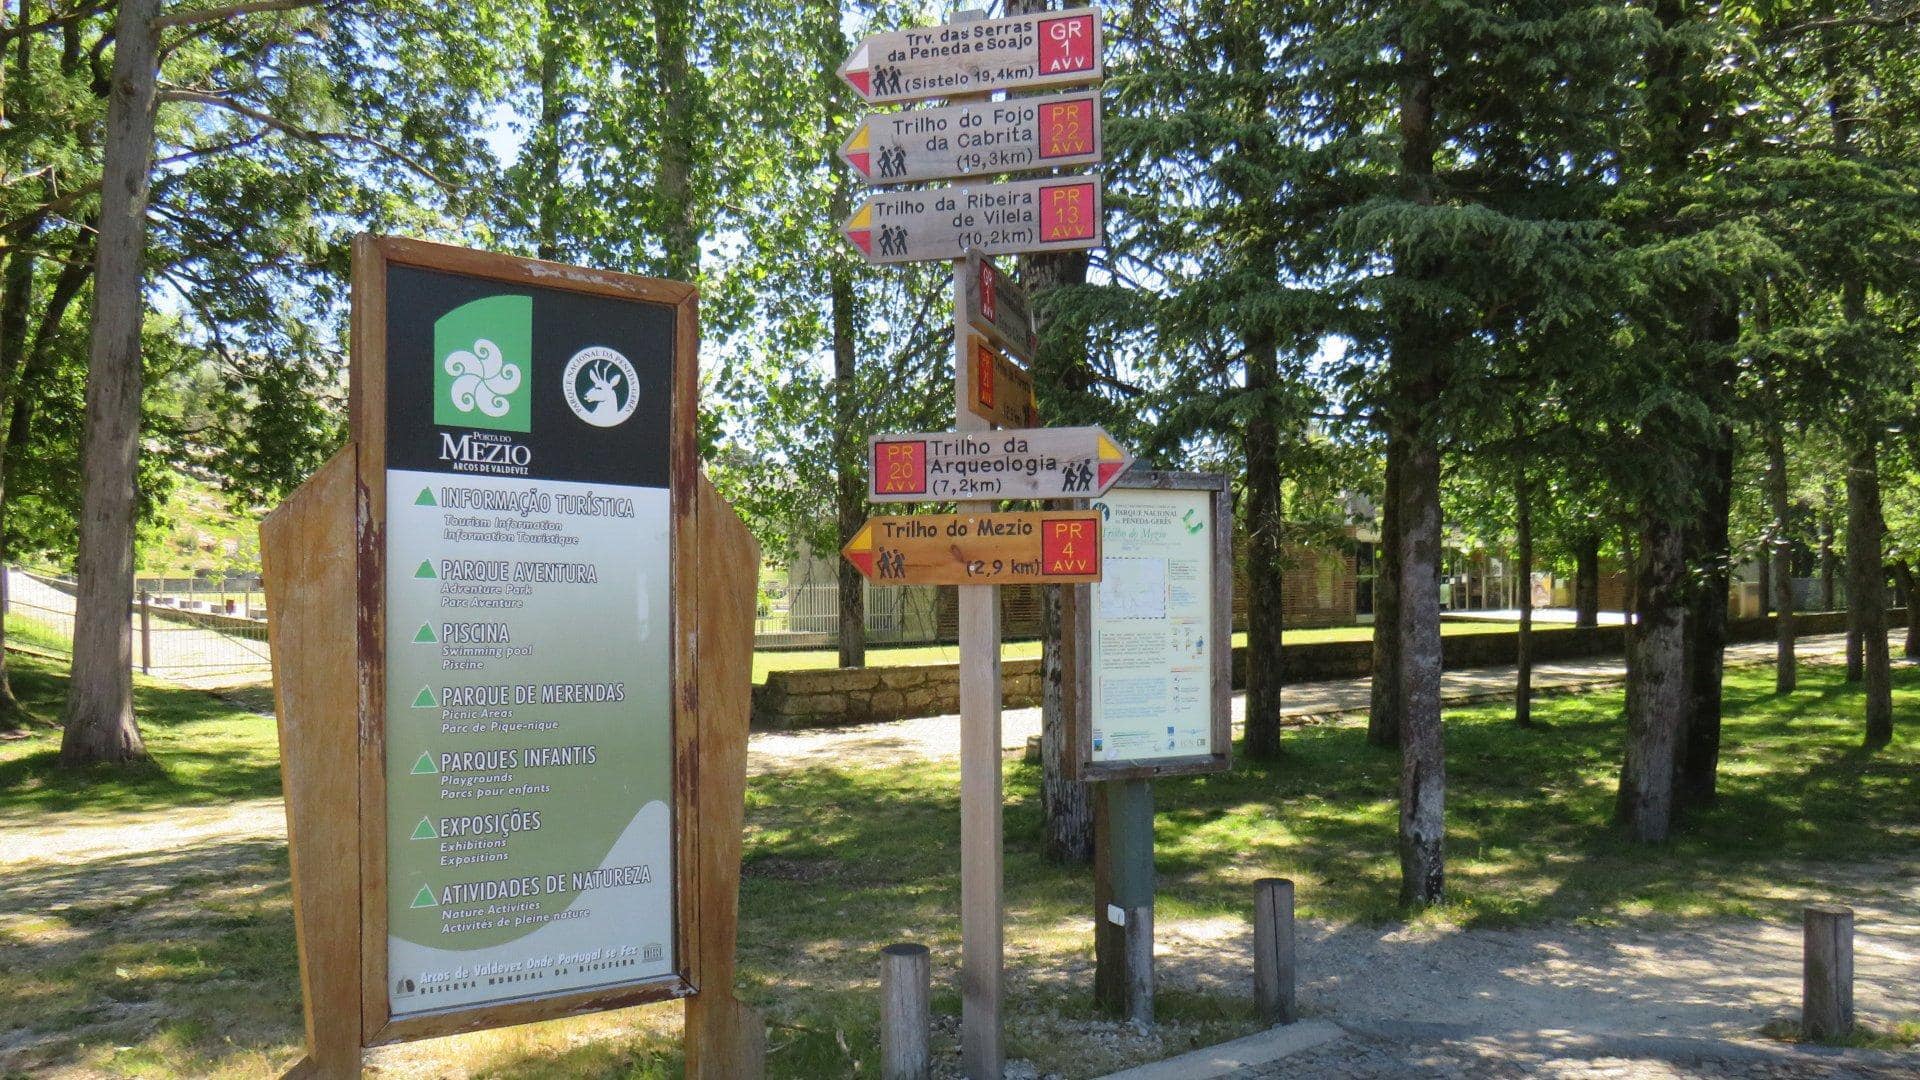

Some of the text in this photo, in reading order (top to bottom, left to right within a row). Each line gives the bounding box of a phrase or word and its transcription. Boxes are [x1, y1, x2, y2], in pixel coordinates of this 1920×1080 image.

[907, 20, 1033, 46] Trv. das Serras
[1050, 20, 1083, 40] GR
[888, 34, 1033, 62] da Peneda e Soajo
[1061, 40, 1070, 56] 1
[1050, 56, 1084, 71] AVV
[905, 66, 1034, 93] (Sistelo 19,4km)
[893, 108, 1034, 136] Trilho do Fojo
[1052, 106, 1079, 122] PR
[926, 128, 1033, 151] da Cabrita
[1051, 124, 1078, 141] 22
[1051, 141, 1084, 154] AVV
[957, 149, 1034, 172] (19,3km)
[875, 190, 1033, 217] Trilho da Ribeira
[1053, 189, 1080, 205] PR
[952, 207, 1033, 228] de Vilela
[1056, 208, 1079, 225] 13
[958, 228, 1034, 248] (10,2km)
[1052, 225, 1085, 237] AVV
[439, 433, 531, 465] MEZIO
[888, 446, 913, 460] PR
[930, 437, 1029, 455] Trilho da
[454, 463, 478, 471] ARCOS
[491, 465, 528, 475] VALDEVEZ
[890, 463, 913, 477] 20
[930, 455, 1057, 475] Arqueologia
[884, 480, 917, 491] AVV
[932, 478, 1001, 496] (7,2km)
[441, 487, 635, 518] INFORMAÇÃO TURÍSTICA
[444, 515, 563, 531] Tourism Information
[882, 519, 1033, 539] Trilho do Mezio
[1055, 523, 1082, 539] PR
[443, 529, 579, 546] Information Touristique
[1062, 541, 1074, 556] 4
[441, 559, 598, 584] PARQUE AVENTURA
[966, 560, 1040, 579] (2,9 km)
[1053, 559, 1086, 571] AVV
[440, 584, 532, 596] Adventure Park
[440, 596, 523, 609] Parc Aventure
[442, 623, 511, 644] PISCINA
[442, 645, 533, 658] Swimming pool
[442, 660, 484, 670] Piscine
[442, 683, 625, 707] PARQUE DE MERENDAS
[442, 709, 513, 720] Picnic Areas
[442, 720, 559, 734] Parc de Pique-nique
[440, 745, 597, 772] PARQUES INFANTIS
[440, 773, 513, 787] Playgrounds
[440, 783, 551, 799] Parcs pour enfants
[440, 808, 542, 837] EXPOSIÇÕES
[440, 839, 507, 852] Exhibitions
[440, 852, 509, 867] Expositions
[441, 865, 651, 905] ATIVIDADES DE NATUREZA
[442, 901, 541, 920] Nature Activities
[441, 908, 590, 934] Activités de pleine nature
[420, 970, 451, 983] Arcos
[455, 966, 469, 979] de
[474, 961, 522, 976] Valdevez
[527, 956, 554, 969] Onde
[558, 947, 602, 964] Portugal
[606, 949, 617, 958] se
[621, 945, 638, 956] Fez
[421, 981, 476, 994] RESERVA
[489, 971, 543, 985] MUNDIAL
[580, 959, 635, 972] BIOSFERA
